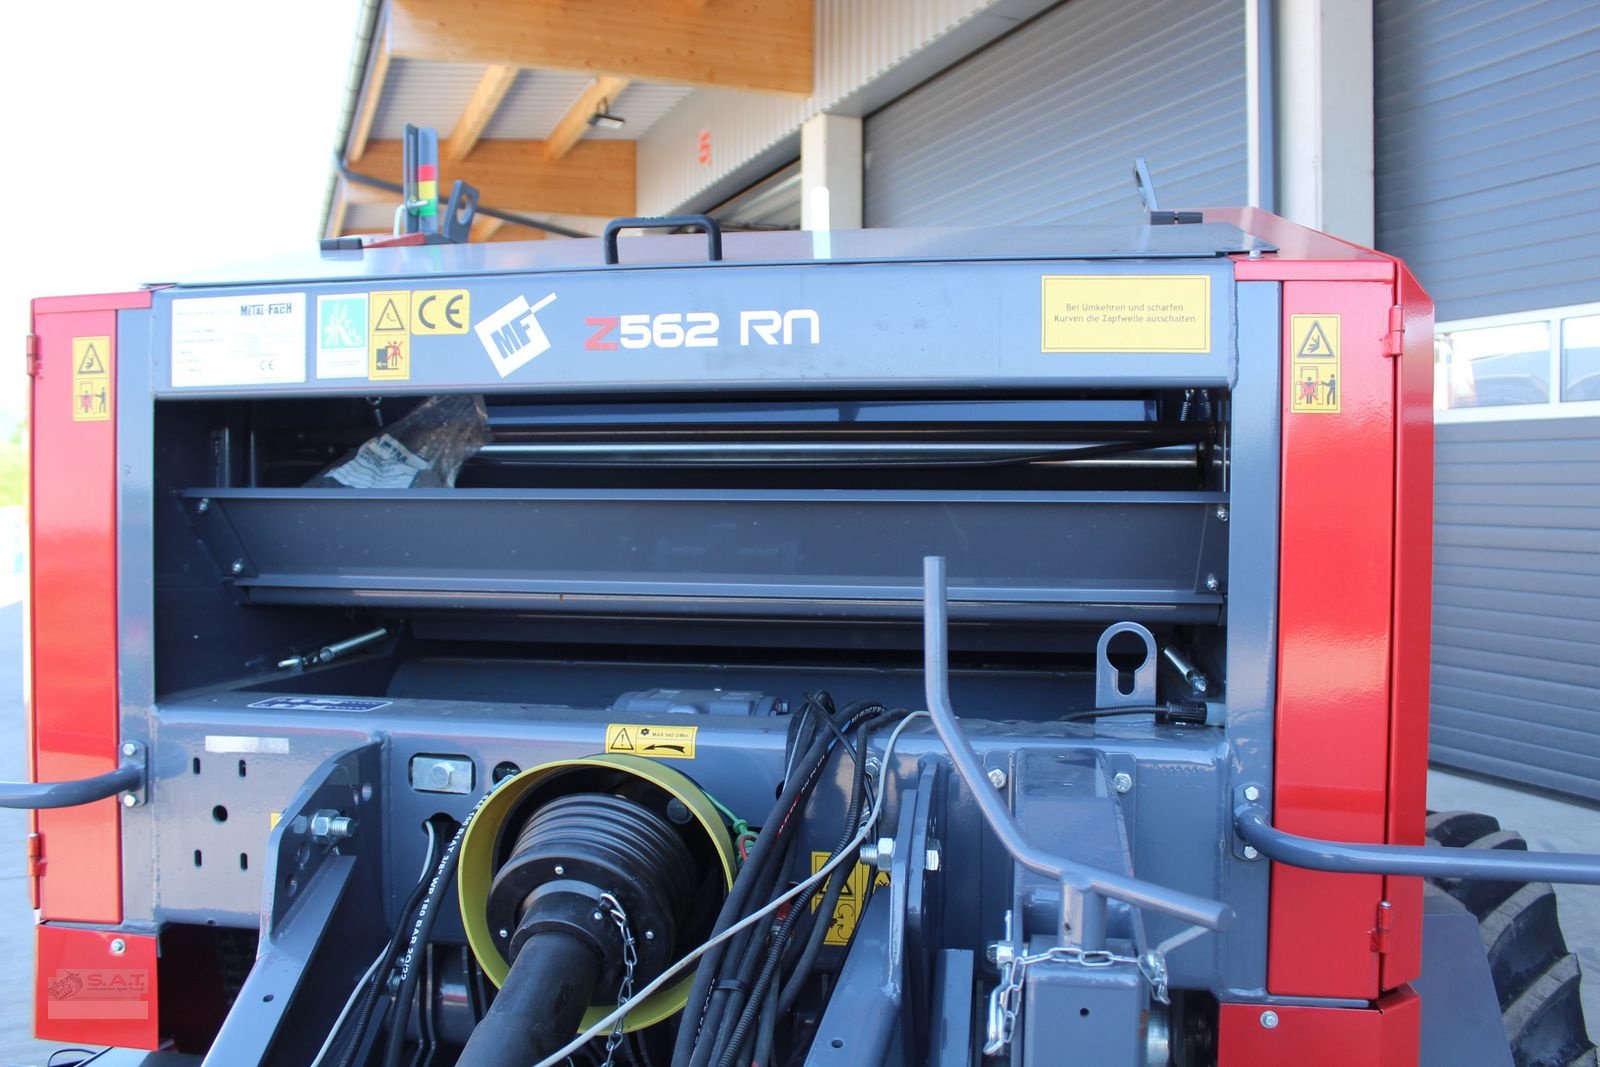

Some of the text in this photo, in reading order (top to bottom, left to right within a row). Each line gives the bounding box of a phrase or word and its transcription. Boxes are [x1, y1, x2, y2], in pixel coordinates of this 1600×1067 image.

[1066, 303, 1184, 311] Bei Umkehren und scharfen
[1054, 314, 1196, 324] Kurven die Zapfwelle ausschalten
[584, 312, 720, 350] Z562
[463, 811, 475, 826] 100
[448, 829, 464, 852] R1AT
[428, 877, 439, 895] WP
[410, 919, 422, 944] BAR
